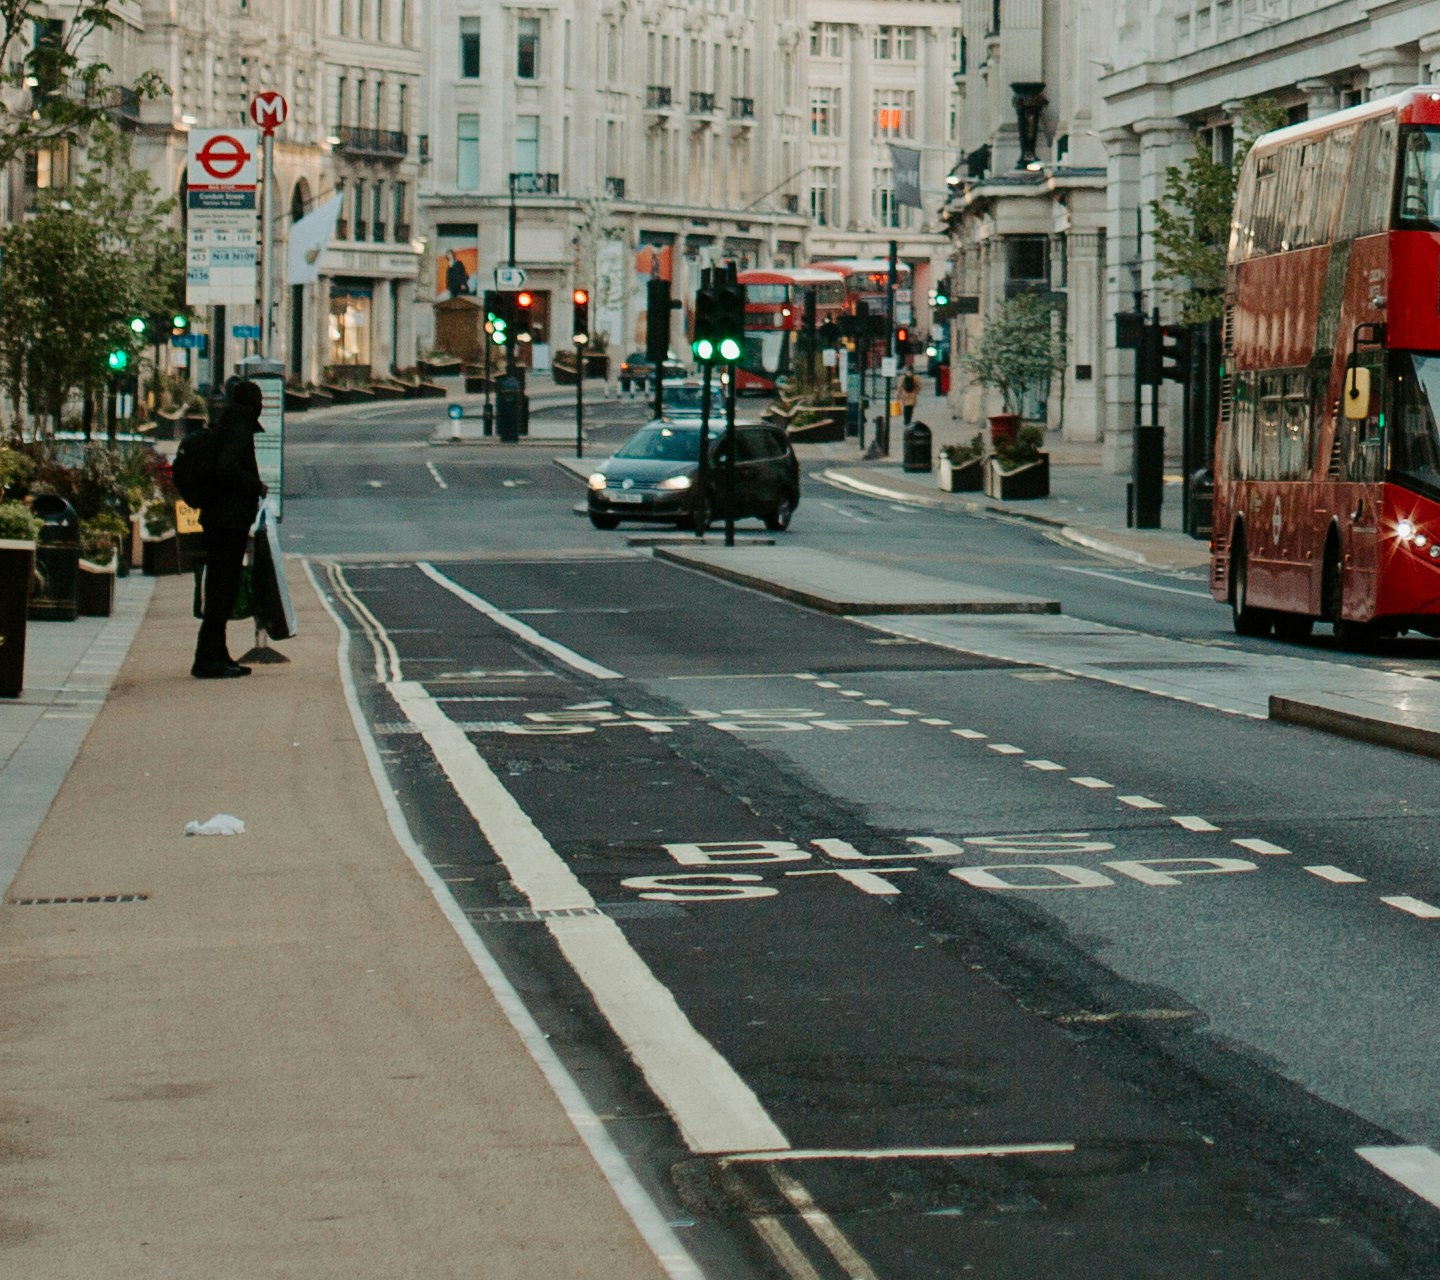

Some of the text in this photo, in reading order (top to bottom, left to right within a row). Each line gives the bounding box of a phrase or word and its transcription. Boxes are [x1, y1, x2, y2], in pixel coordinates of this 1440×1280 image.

[256, 96, 284, 124] M
[659, 832, 1117, 867] BUS
[619, 856, 1261, 902] STOP
